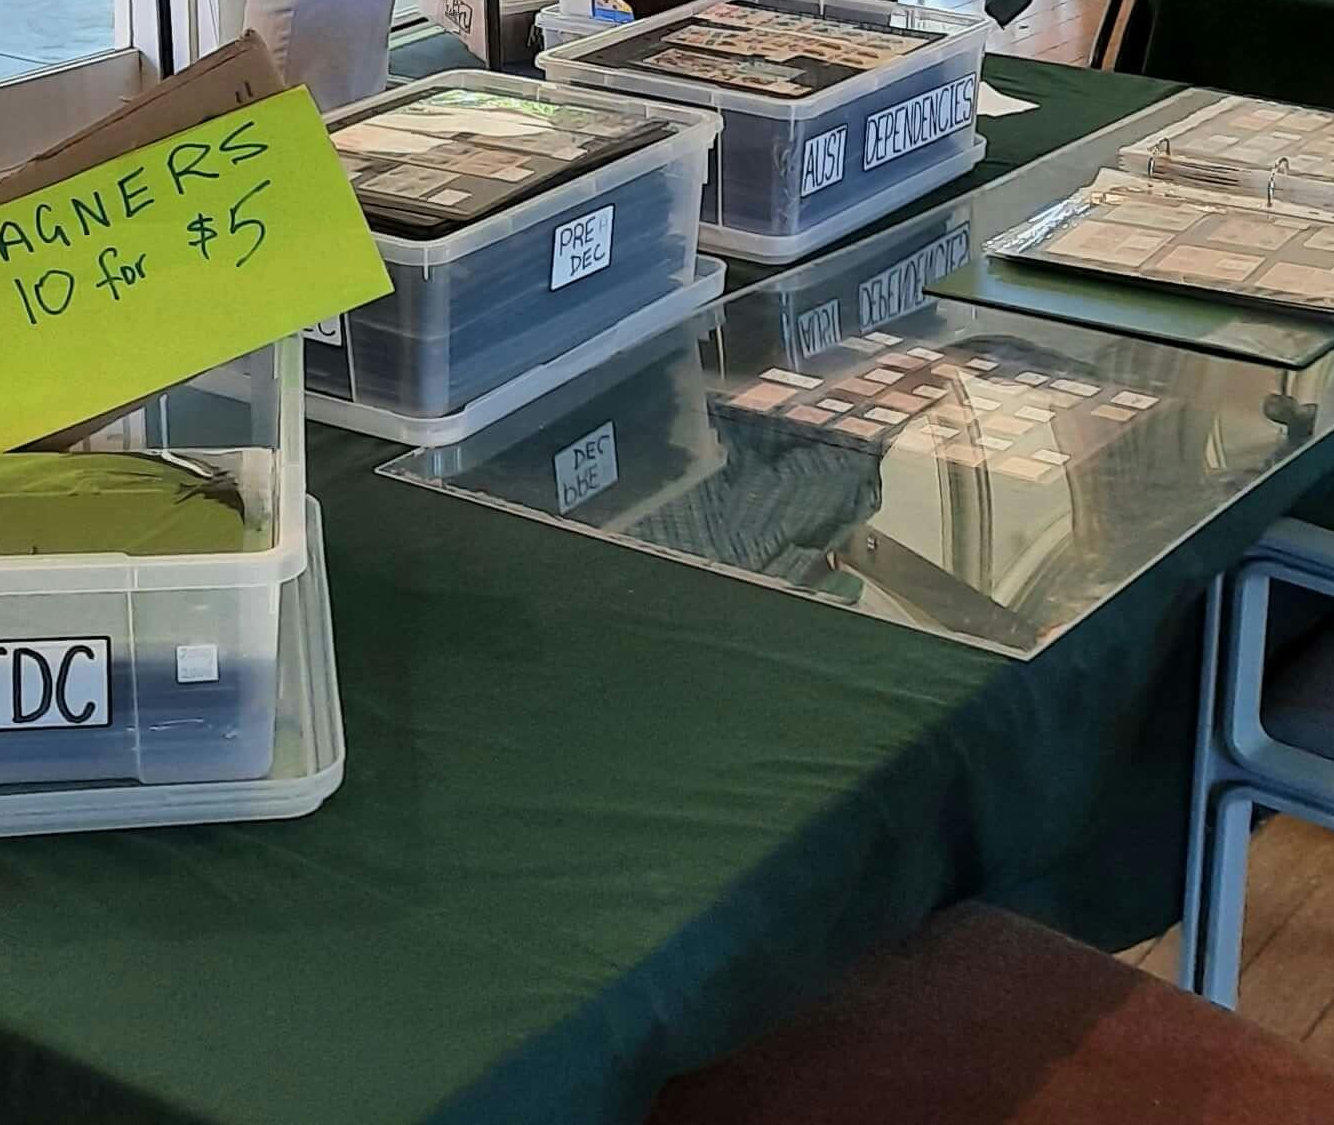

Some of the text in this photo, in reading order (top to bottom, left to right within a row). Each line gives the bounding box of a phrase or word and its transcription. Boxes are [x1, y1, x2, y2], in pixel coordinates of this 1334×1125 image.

[804, 77, 974, 192] AUST DEPENDENCIES
[15, 180, 272, 324] 10 for $5
[560, 216, 595, 256] PRE
[570, 243, 605, 276] DEC
